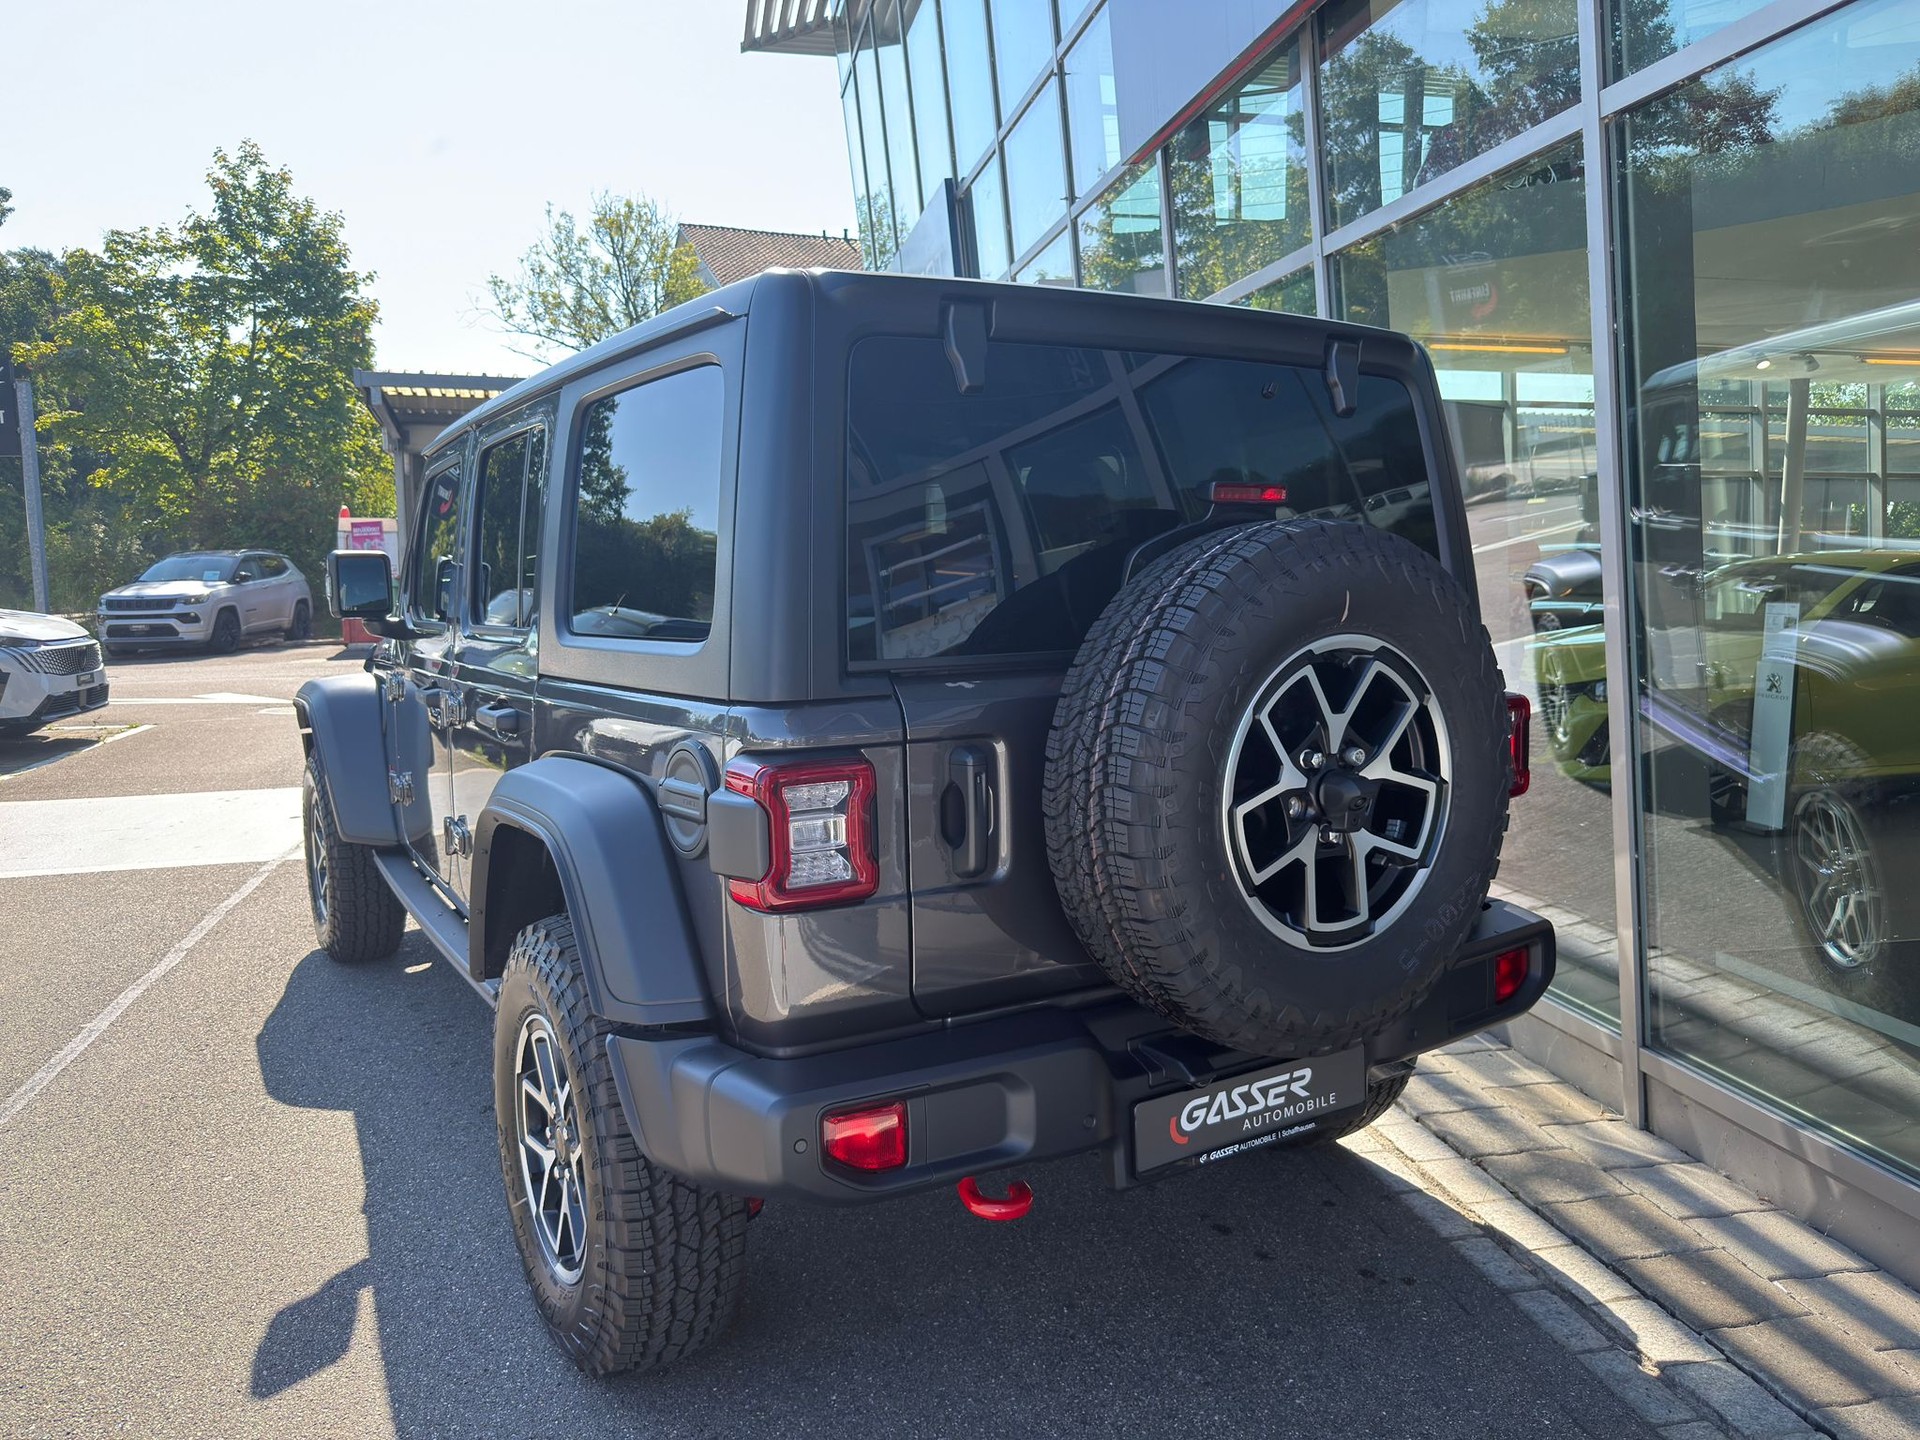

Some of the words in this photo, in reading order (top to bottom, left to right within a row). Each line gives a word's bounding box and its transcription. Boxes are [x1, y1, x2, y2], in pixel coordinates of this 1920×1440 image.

[1180, 1067, 1312, 1131] GASSER
[1242, 1092, 1336, 1131] AUTOMOBILE
[1210, 1144, 1239, 1160] GASSER
[1240, 1132, 1277, 1151] AUTOMOBILE
[1282, 1122, 1316, 1138] Schaffhausen
